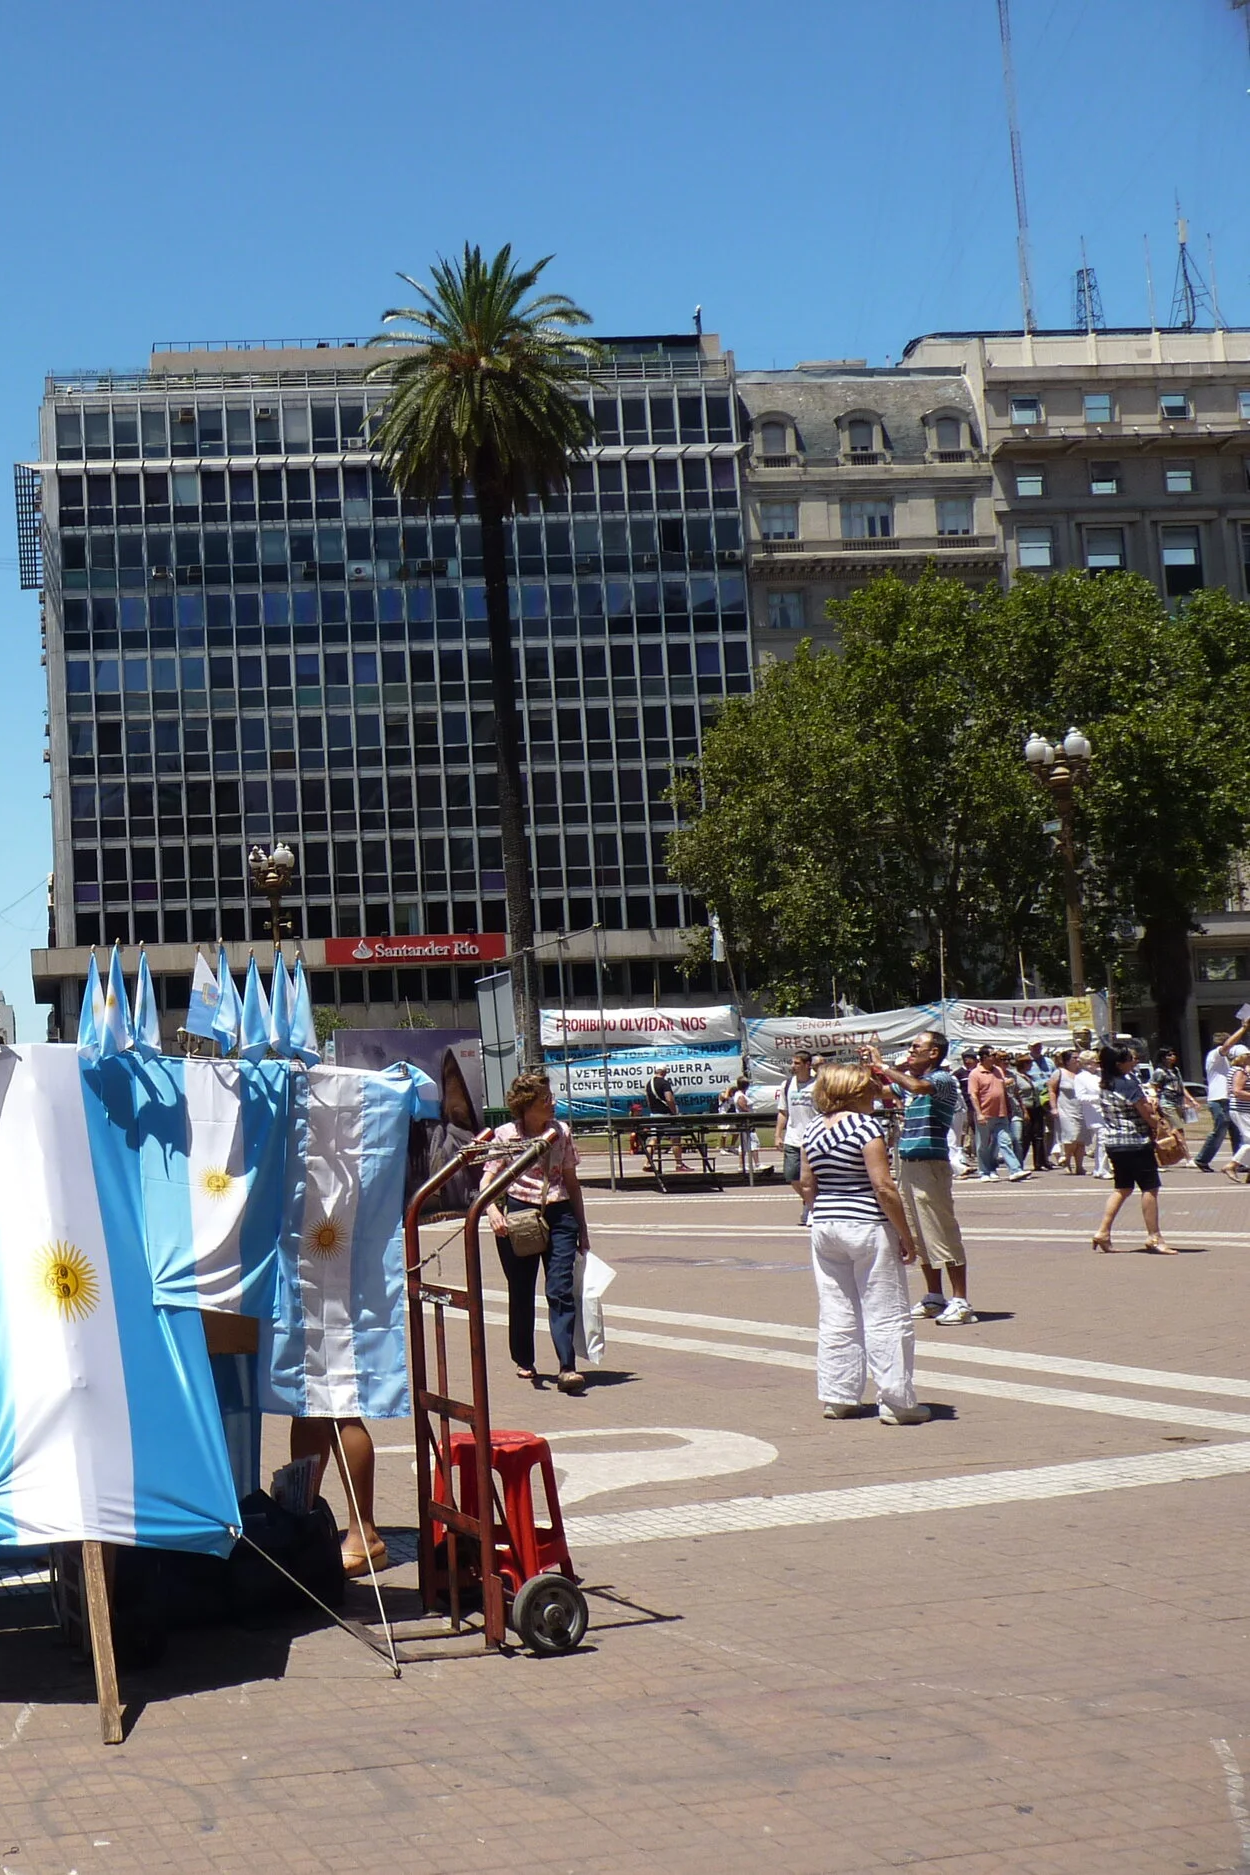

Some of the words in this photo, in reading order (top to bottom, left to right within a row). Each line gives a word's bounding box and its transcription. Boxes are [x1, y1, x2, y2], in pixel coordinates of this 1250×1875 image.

[374, 941, 450, 958] Santander
[1012, 1004, 1067, 1027] LOCO
[556, 1018, 617, 1033] PROHIBIDO
[620, 1017, 674, 1032] OLVIDAR
[680, 1016, 707, 1031] NOS
[775, 1030, 883, 1050] PRESIDENTA
[575, 1066, 643, 1079] VETERANOS
[665, 1062, 713, 1075] GUERRA
[626, 1079, 645, 1090] DEL
[667, 1075, 704, 1088] ANTICO
[708, 1074, 731, 1085] SUR
